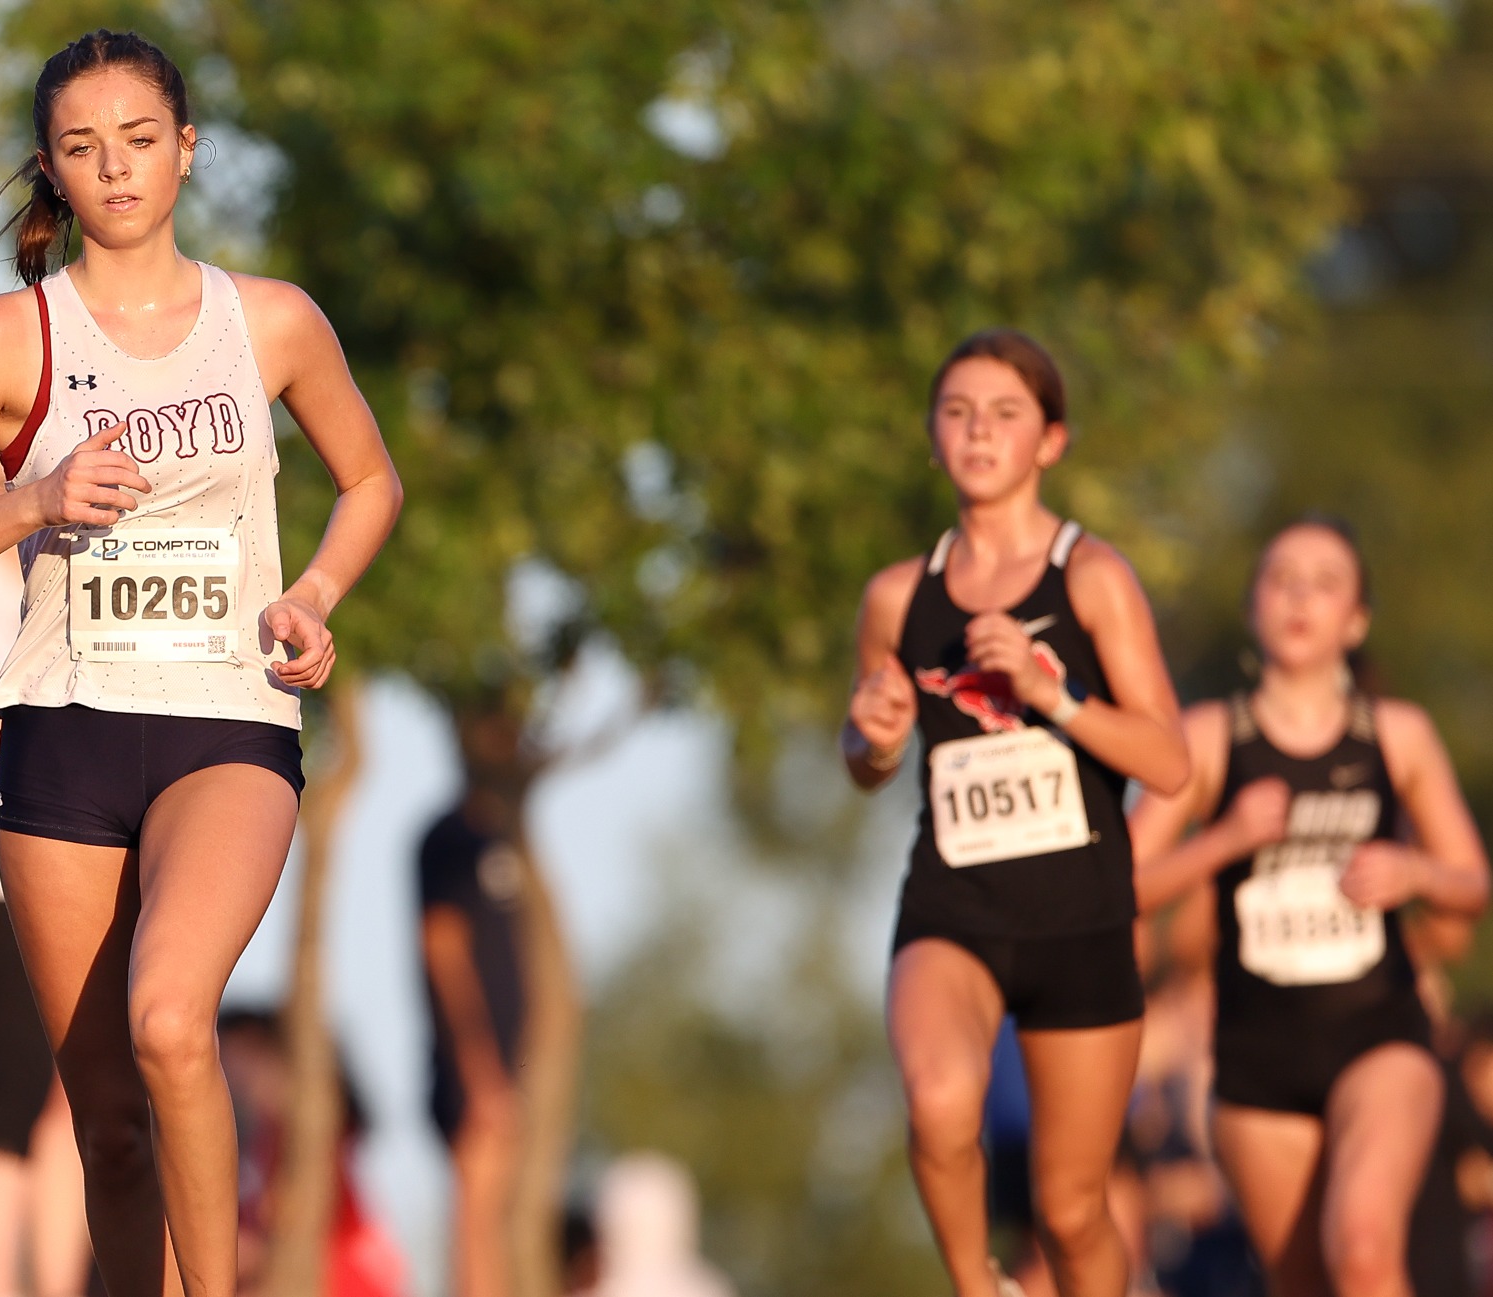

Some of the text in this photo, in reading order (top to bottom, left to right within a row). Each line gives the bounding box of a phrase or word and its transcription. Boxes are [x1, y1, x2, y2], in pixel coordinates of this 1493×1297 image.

[132, 540, 219, 551] COMPTON
[82, 575, 229, 620] 10265
[944, 769, 1064, 824] 10517
